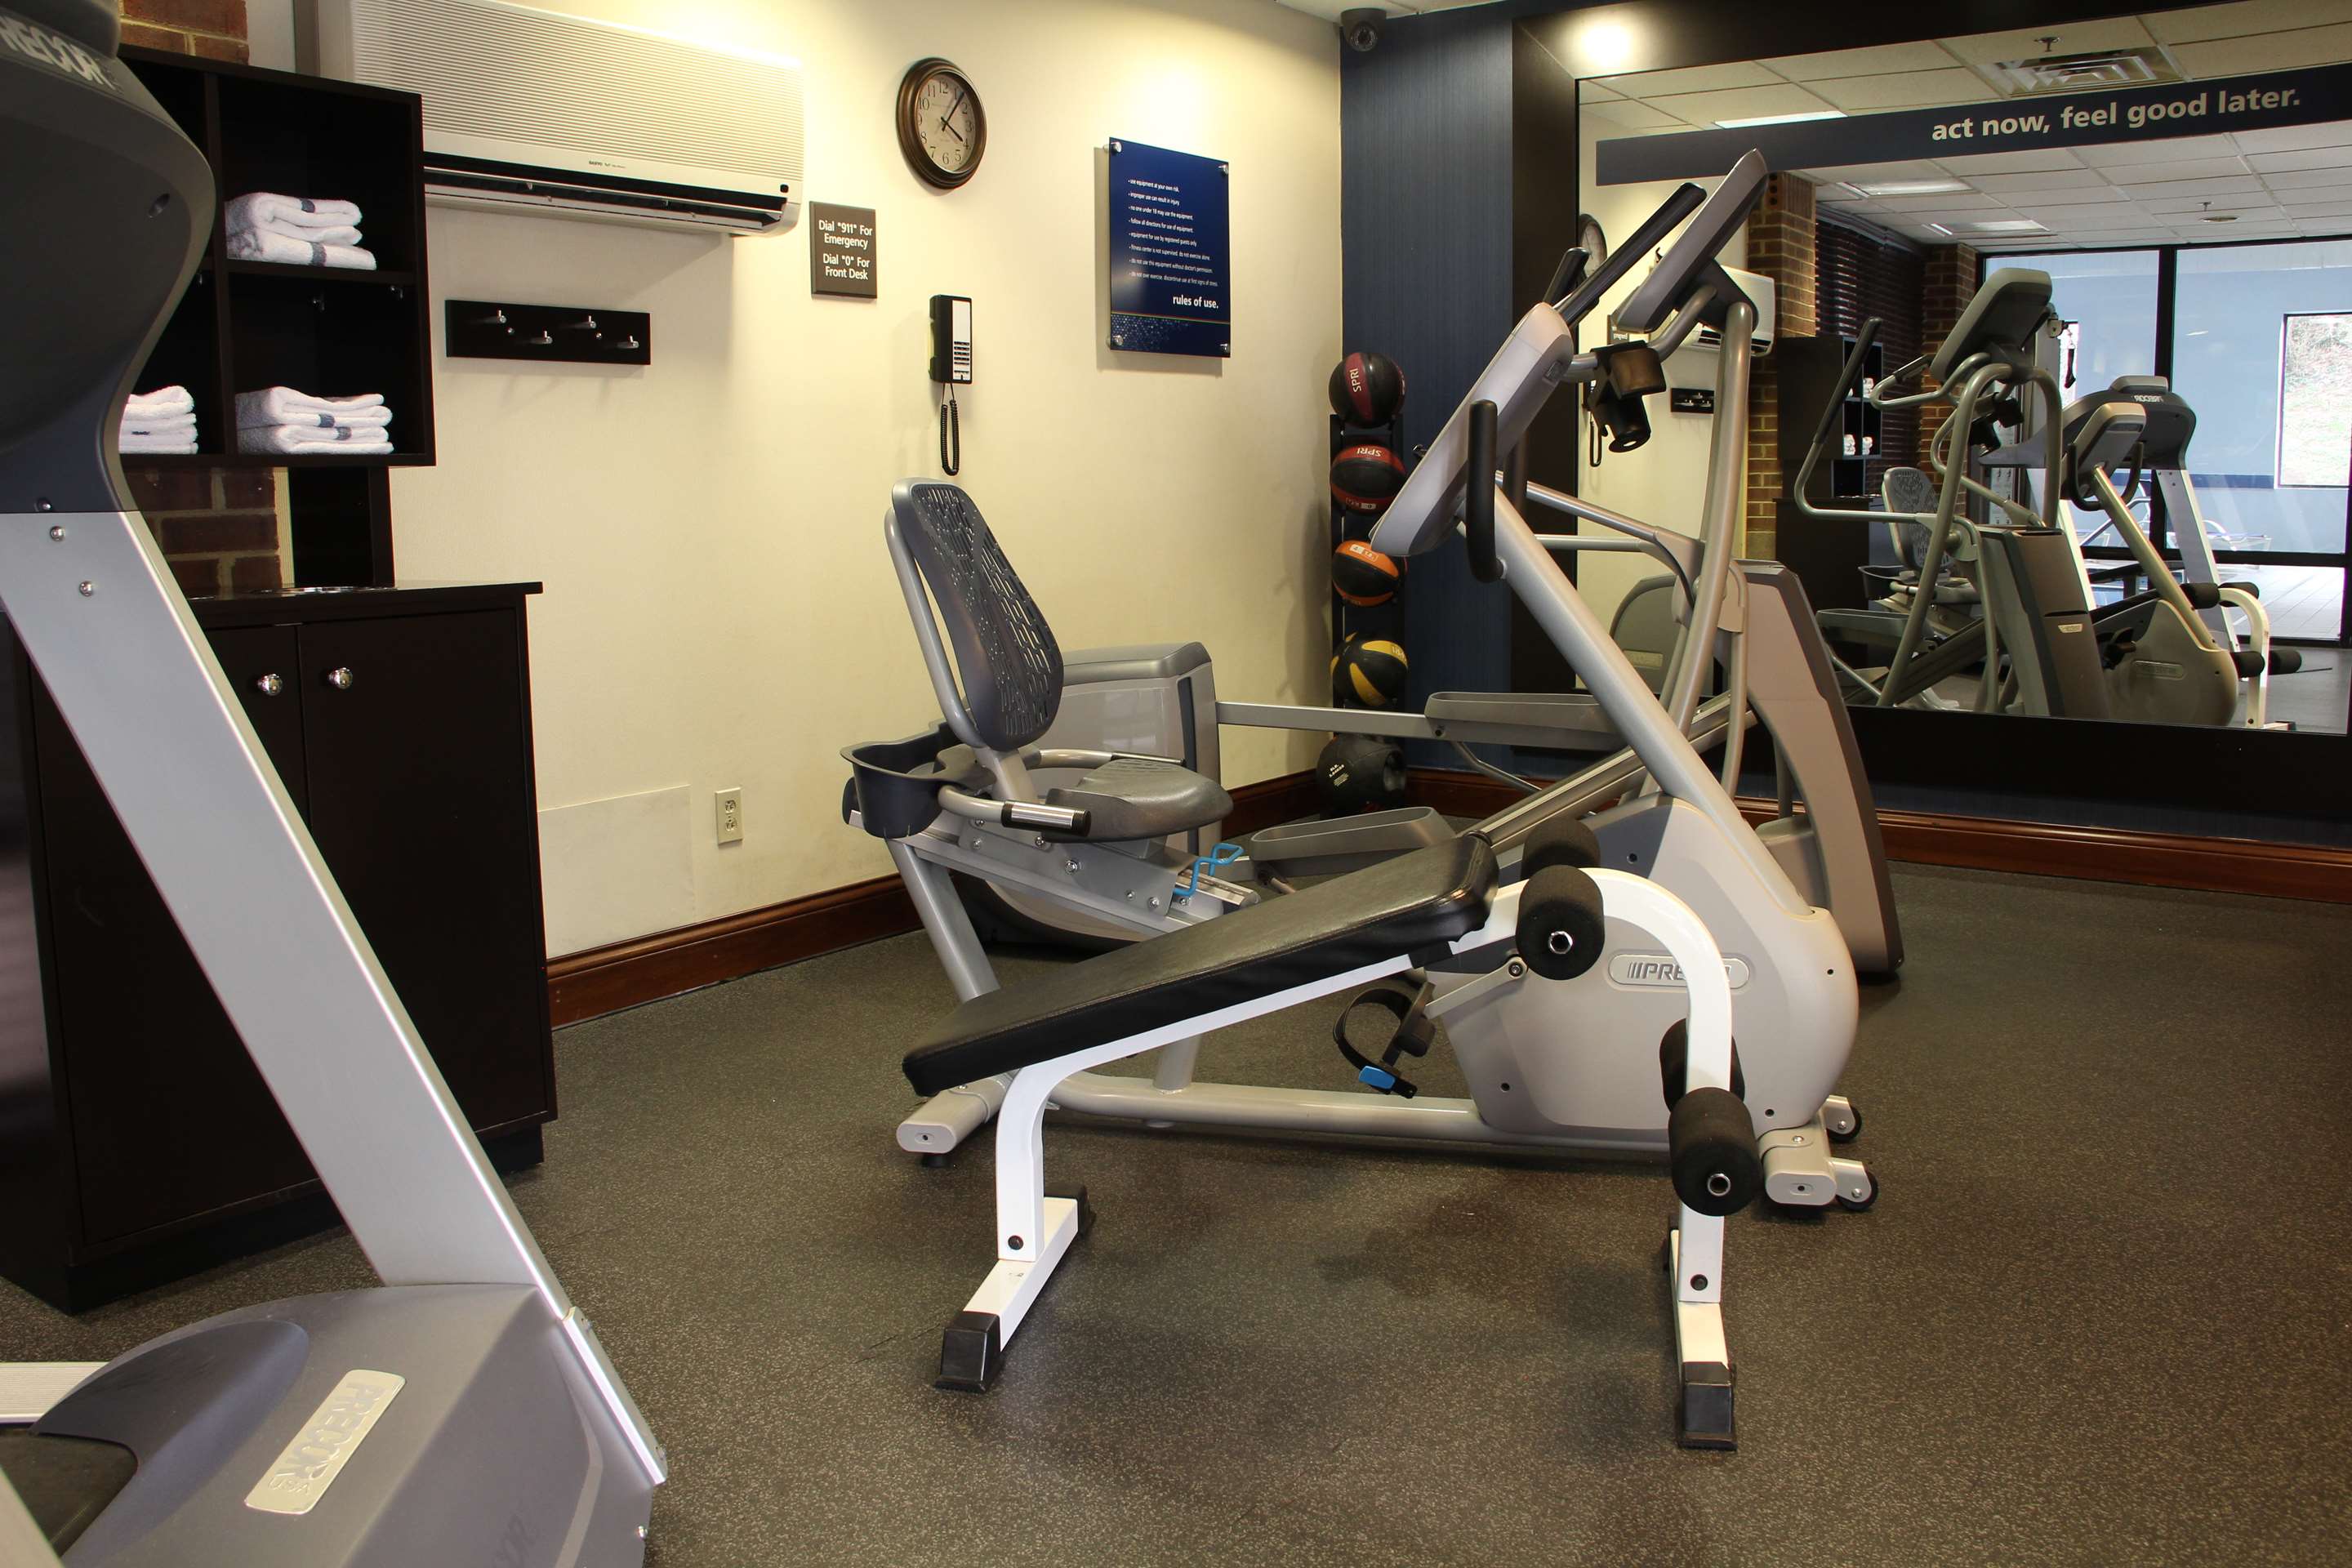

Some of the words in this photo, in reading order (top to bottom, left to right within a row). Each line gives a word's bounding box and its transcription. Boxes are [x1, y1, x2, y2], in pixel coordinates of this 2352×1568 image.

[0, 15, 116, 91] RECOR
[928, 84, 936, 97] 11
[939, 81, 948, 94] 12
[919, 98, 929, 110] 10
[962, 102, 968, 114] 2
[1932, 117, 1974, 140] act
[1982, 113, 2051, 137] now,
[2060, 102, 2117, 129] feel
[2127, 92, 2207, 128] good
[2218, 87, 2301, 114] later.
[965, 120, 973, 131] 3
[920, 131, 927, 144] 8
[963, 139, 970, 150] 4
[929, 146, 936, 158] 7
[942, 152, 949, 164] 6
[955, 149, 961, 162] 5
[819, 220, 835, 231] Dial
[837, 222, 857, 234] "911"
[860, 225, 872, 236] For
[824, 234, 868, 249] Emergency
[823, 253, 839, 265] Dial
[842, 256, 854, 265] "0"
[857, 257, 870, 268] For
[1156, 261, 1171, 269] equipment
[825, 266, 847, 278] Front
[849, 269, 868, 280] Desk
[1172, 294, 1192, 306] rules
[1193, 296, 1202, 307] of
[1203, 297, 1219, 310] use.
[1350, 368, 1361, 392] SPRI
[1356, 448, 1382, 457] SPRI
[1643, 962, 1732, 981] PRE
[274, 1381, 389, 1481] PRECOR
